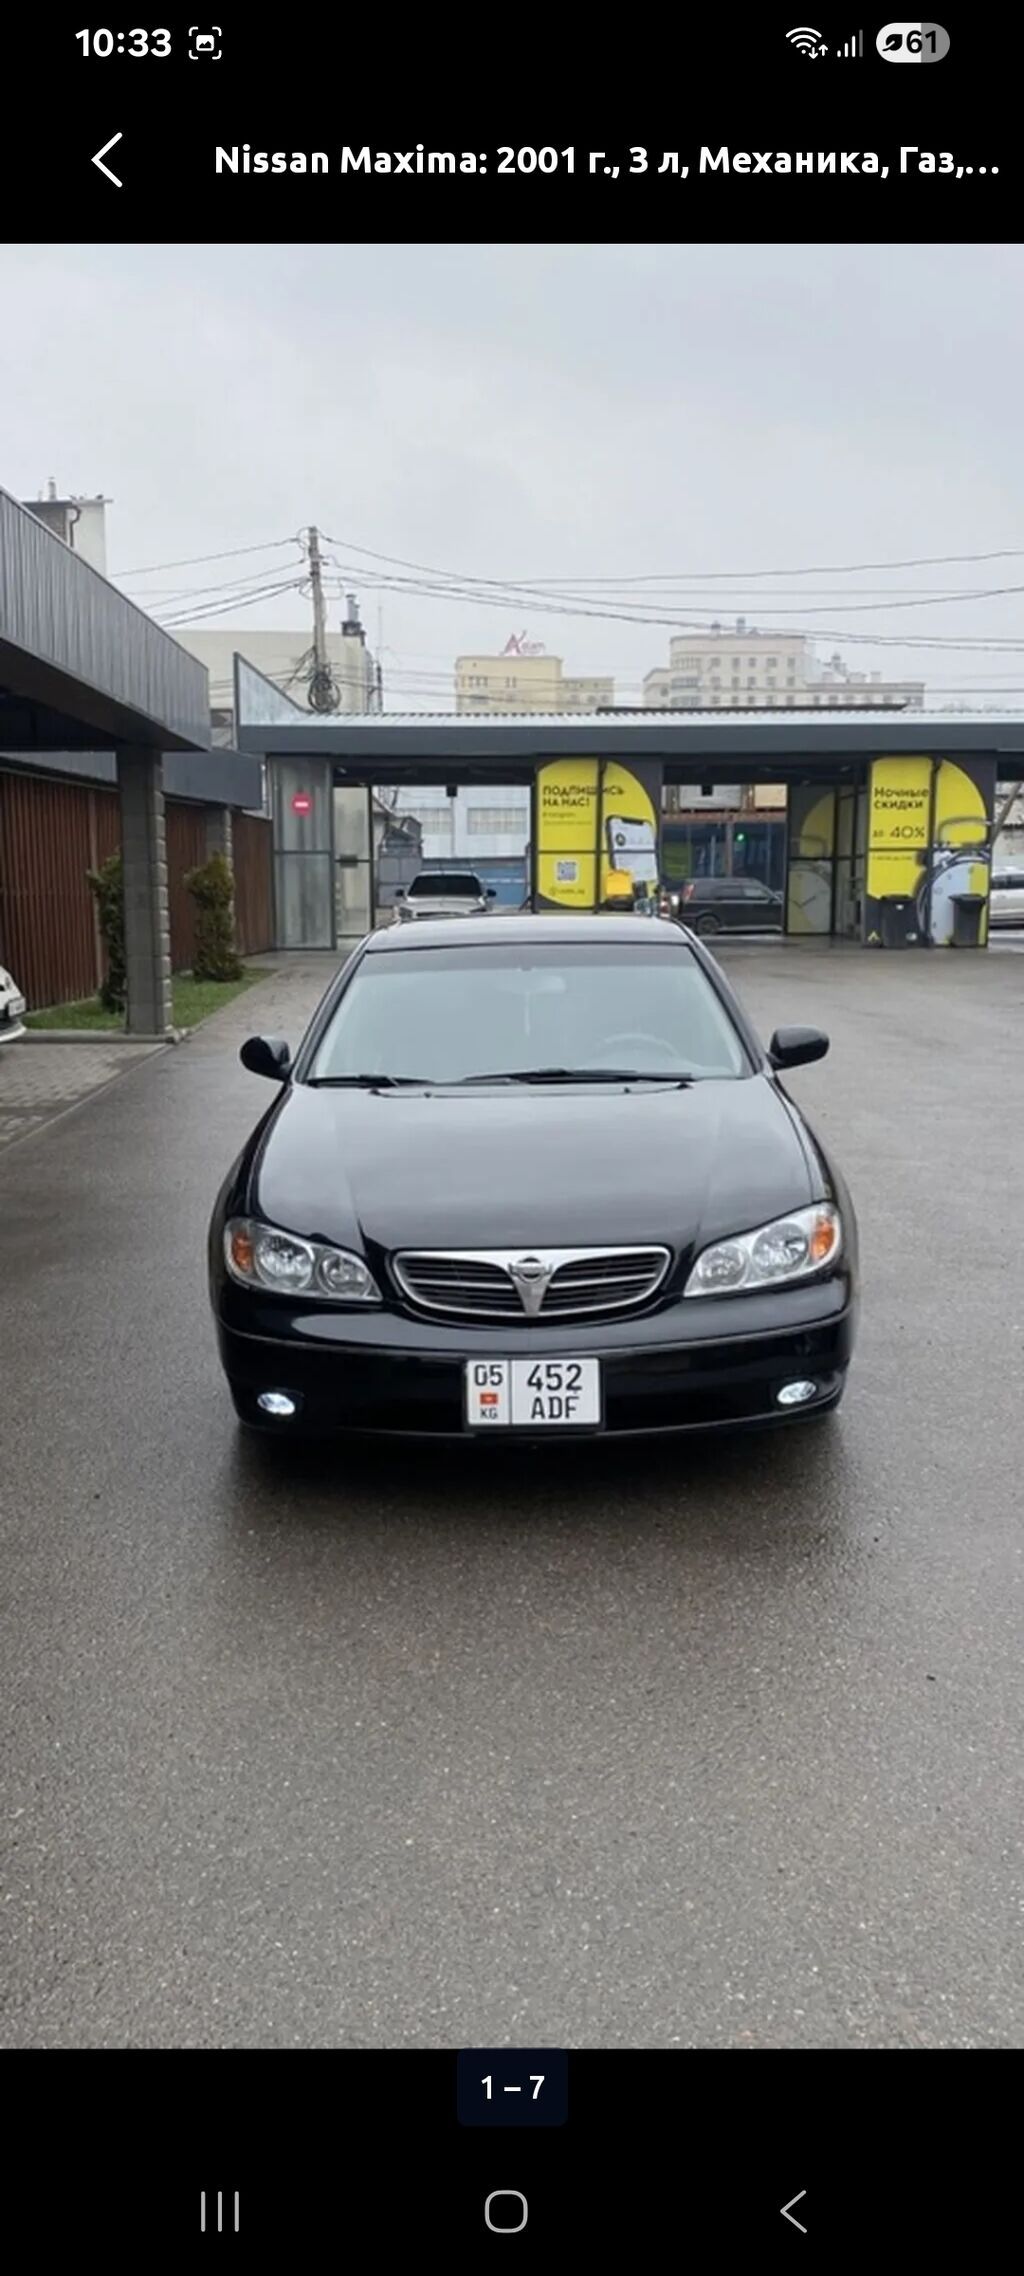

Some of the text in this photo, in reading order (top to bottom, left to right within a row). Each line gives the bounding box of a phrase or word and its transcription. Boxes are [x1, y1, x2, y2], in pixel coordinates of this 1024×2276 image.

[874, 787, 929, 798] Ночные
[543, 797, 590, 807] НА НАС!
[874, 800, 923, 810] скидки
[890, 826, 925, 839] 40%
[474, 1364, 503, 1386] 05
[527, 1364, 582, 1391] 452
[480, 1407, 498, 1419] KG
[531, 1396, 579, 1419] ADF
